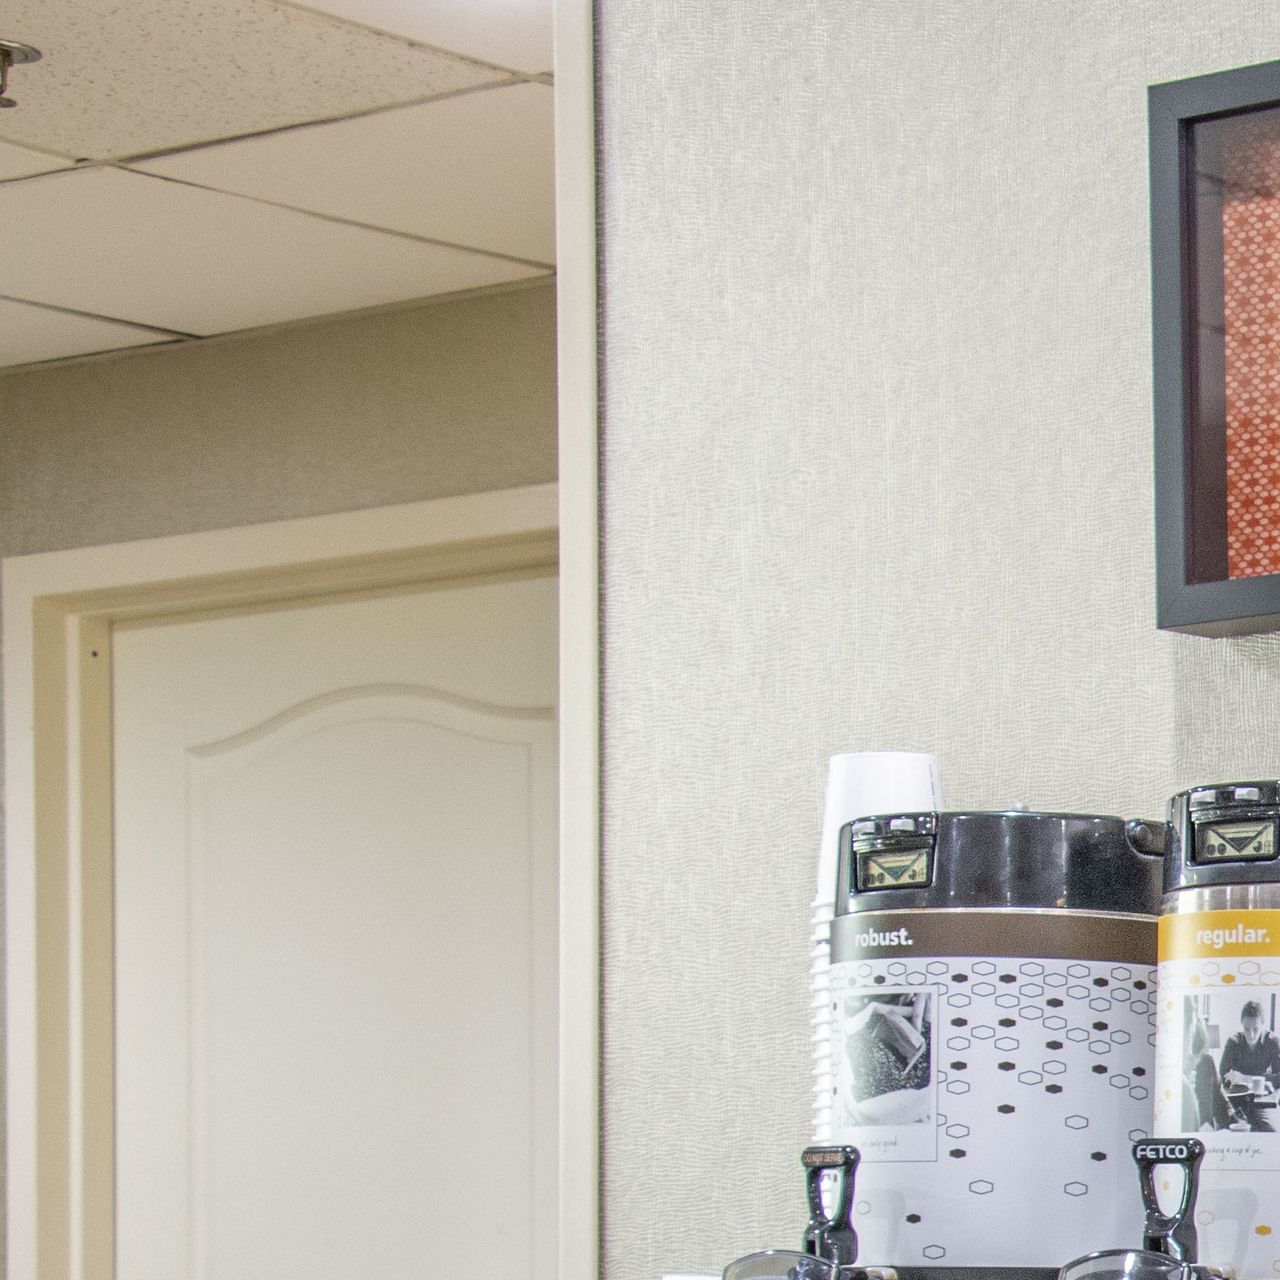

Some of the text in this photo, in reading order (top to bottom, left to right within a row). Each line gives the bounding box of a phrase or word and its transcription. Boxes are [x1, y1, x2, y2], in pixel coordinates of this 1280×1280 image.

[854, 927, 914, 947] robust.
[1196, 923, 1271, 949] regular.
[1136, 1145, 1187, 1159] FETCO
